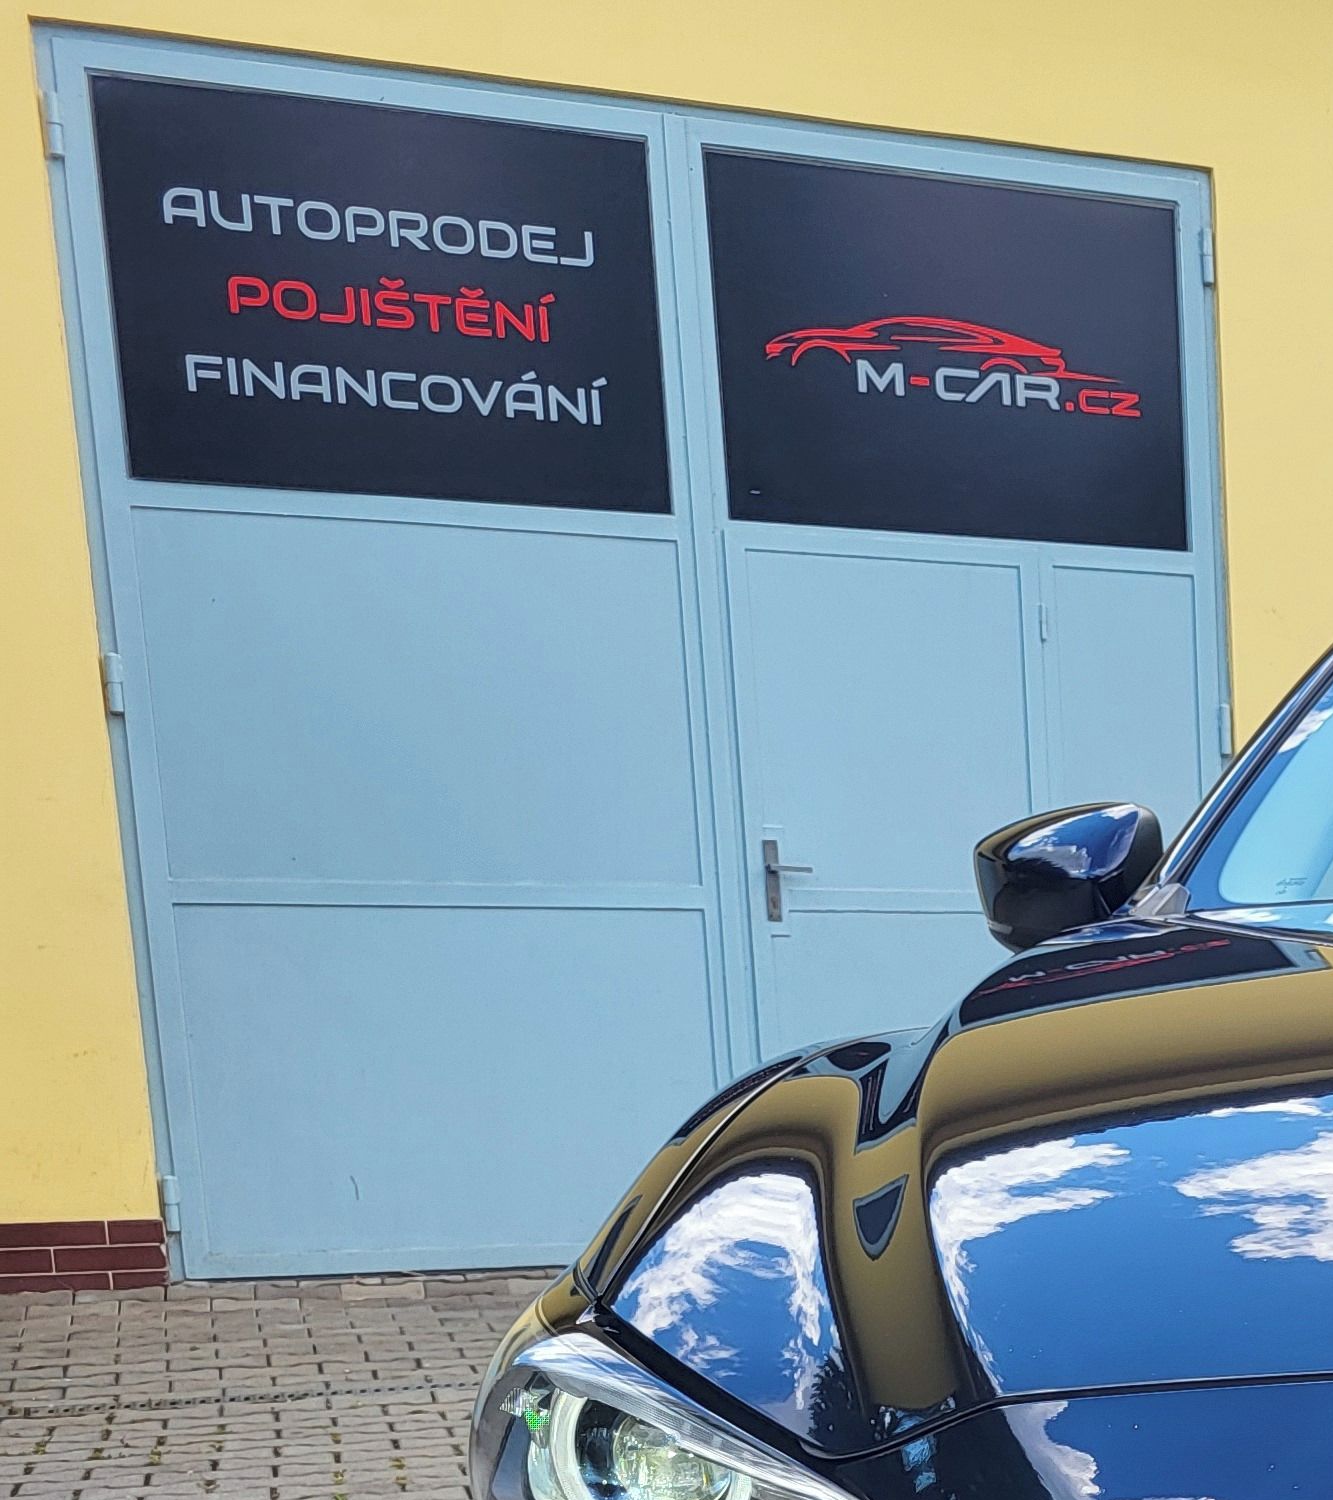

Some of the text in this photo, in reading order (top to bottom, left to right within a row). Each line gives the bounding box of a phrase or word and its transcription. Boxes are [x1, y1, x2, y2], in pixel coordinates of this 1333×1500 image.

[162, 186, 595, 268] AUTOPRODEJ
[227, 276, 556, 343] POJIŠTĚNÍ
[184, 353, 608, 426] FINANCOVÁNÍ
